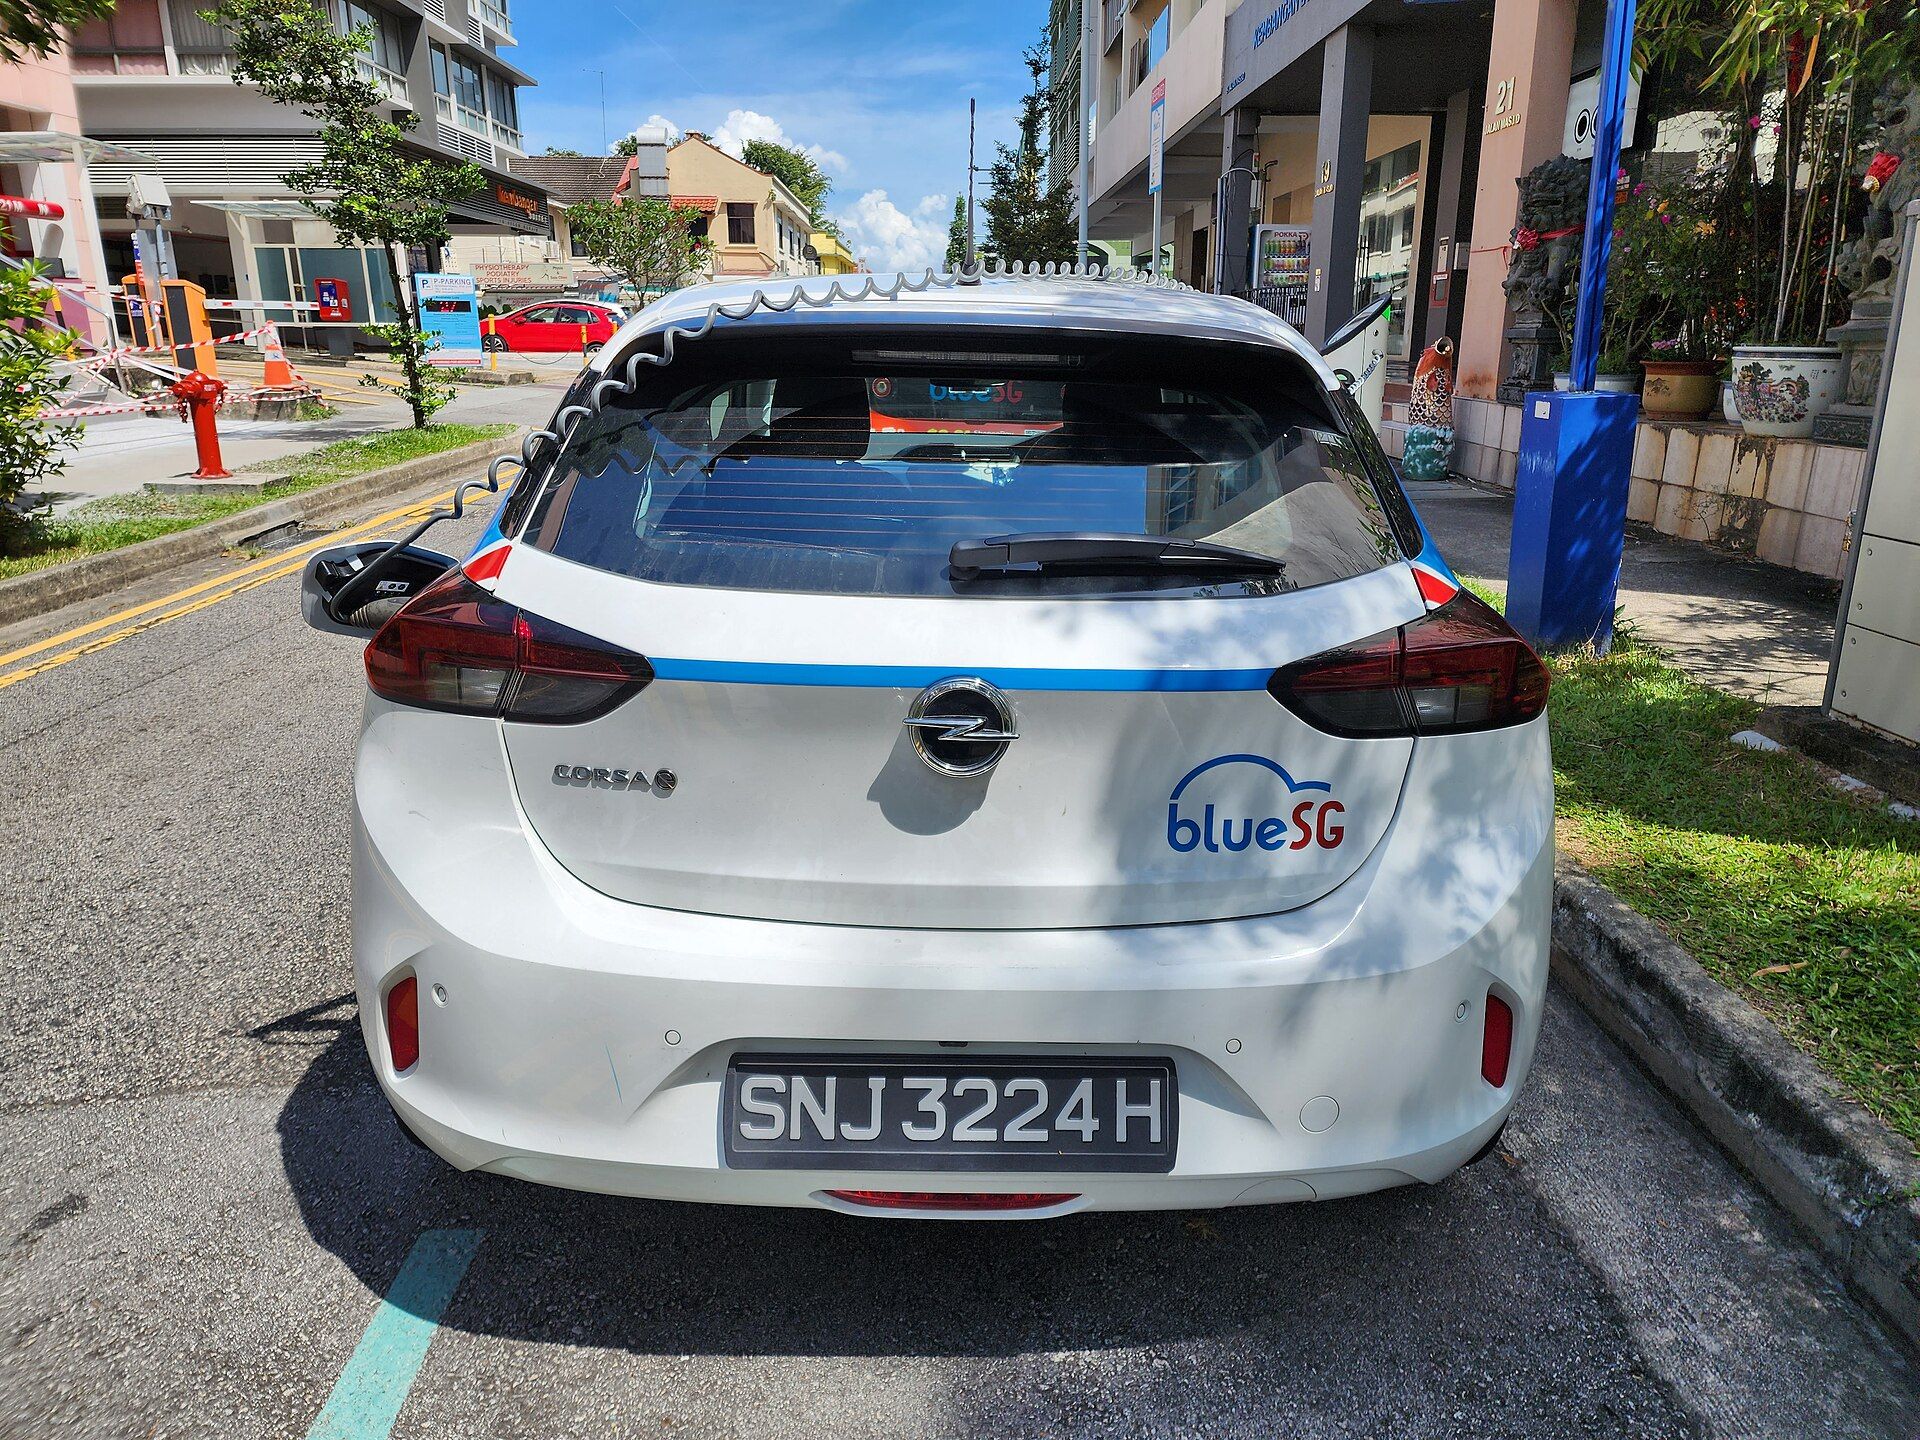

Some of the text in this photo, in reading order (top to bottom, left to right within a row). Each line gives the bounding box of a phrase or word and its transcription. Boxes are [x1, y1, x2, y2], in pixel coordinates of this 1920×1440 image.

[1495, 77, 1516, 115] 21
[433, 278, 471, 286] P-PARKING
[552, 764, 651, 790] CORSA
[1167, 800, 1345, 853] blueSG
[739, 1077, 1161, 1143] SNJ 3224 H
